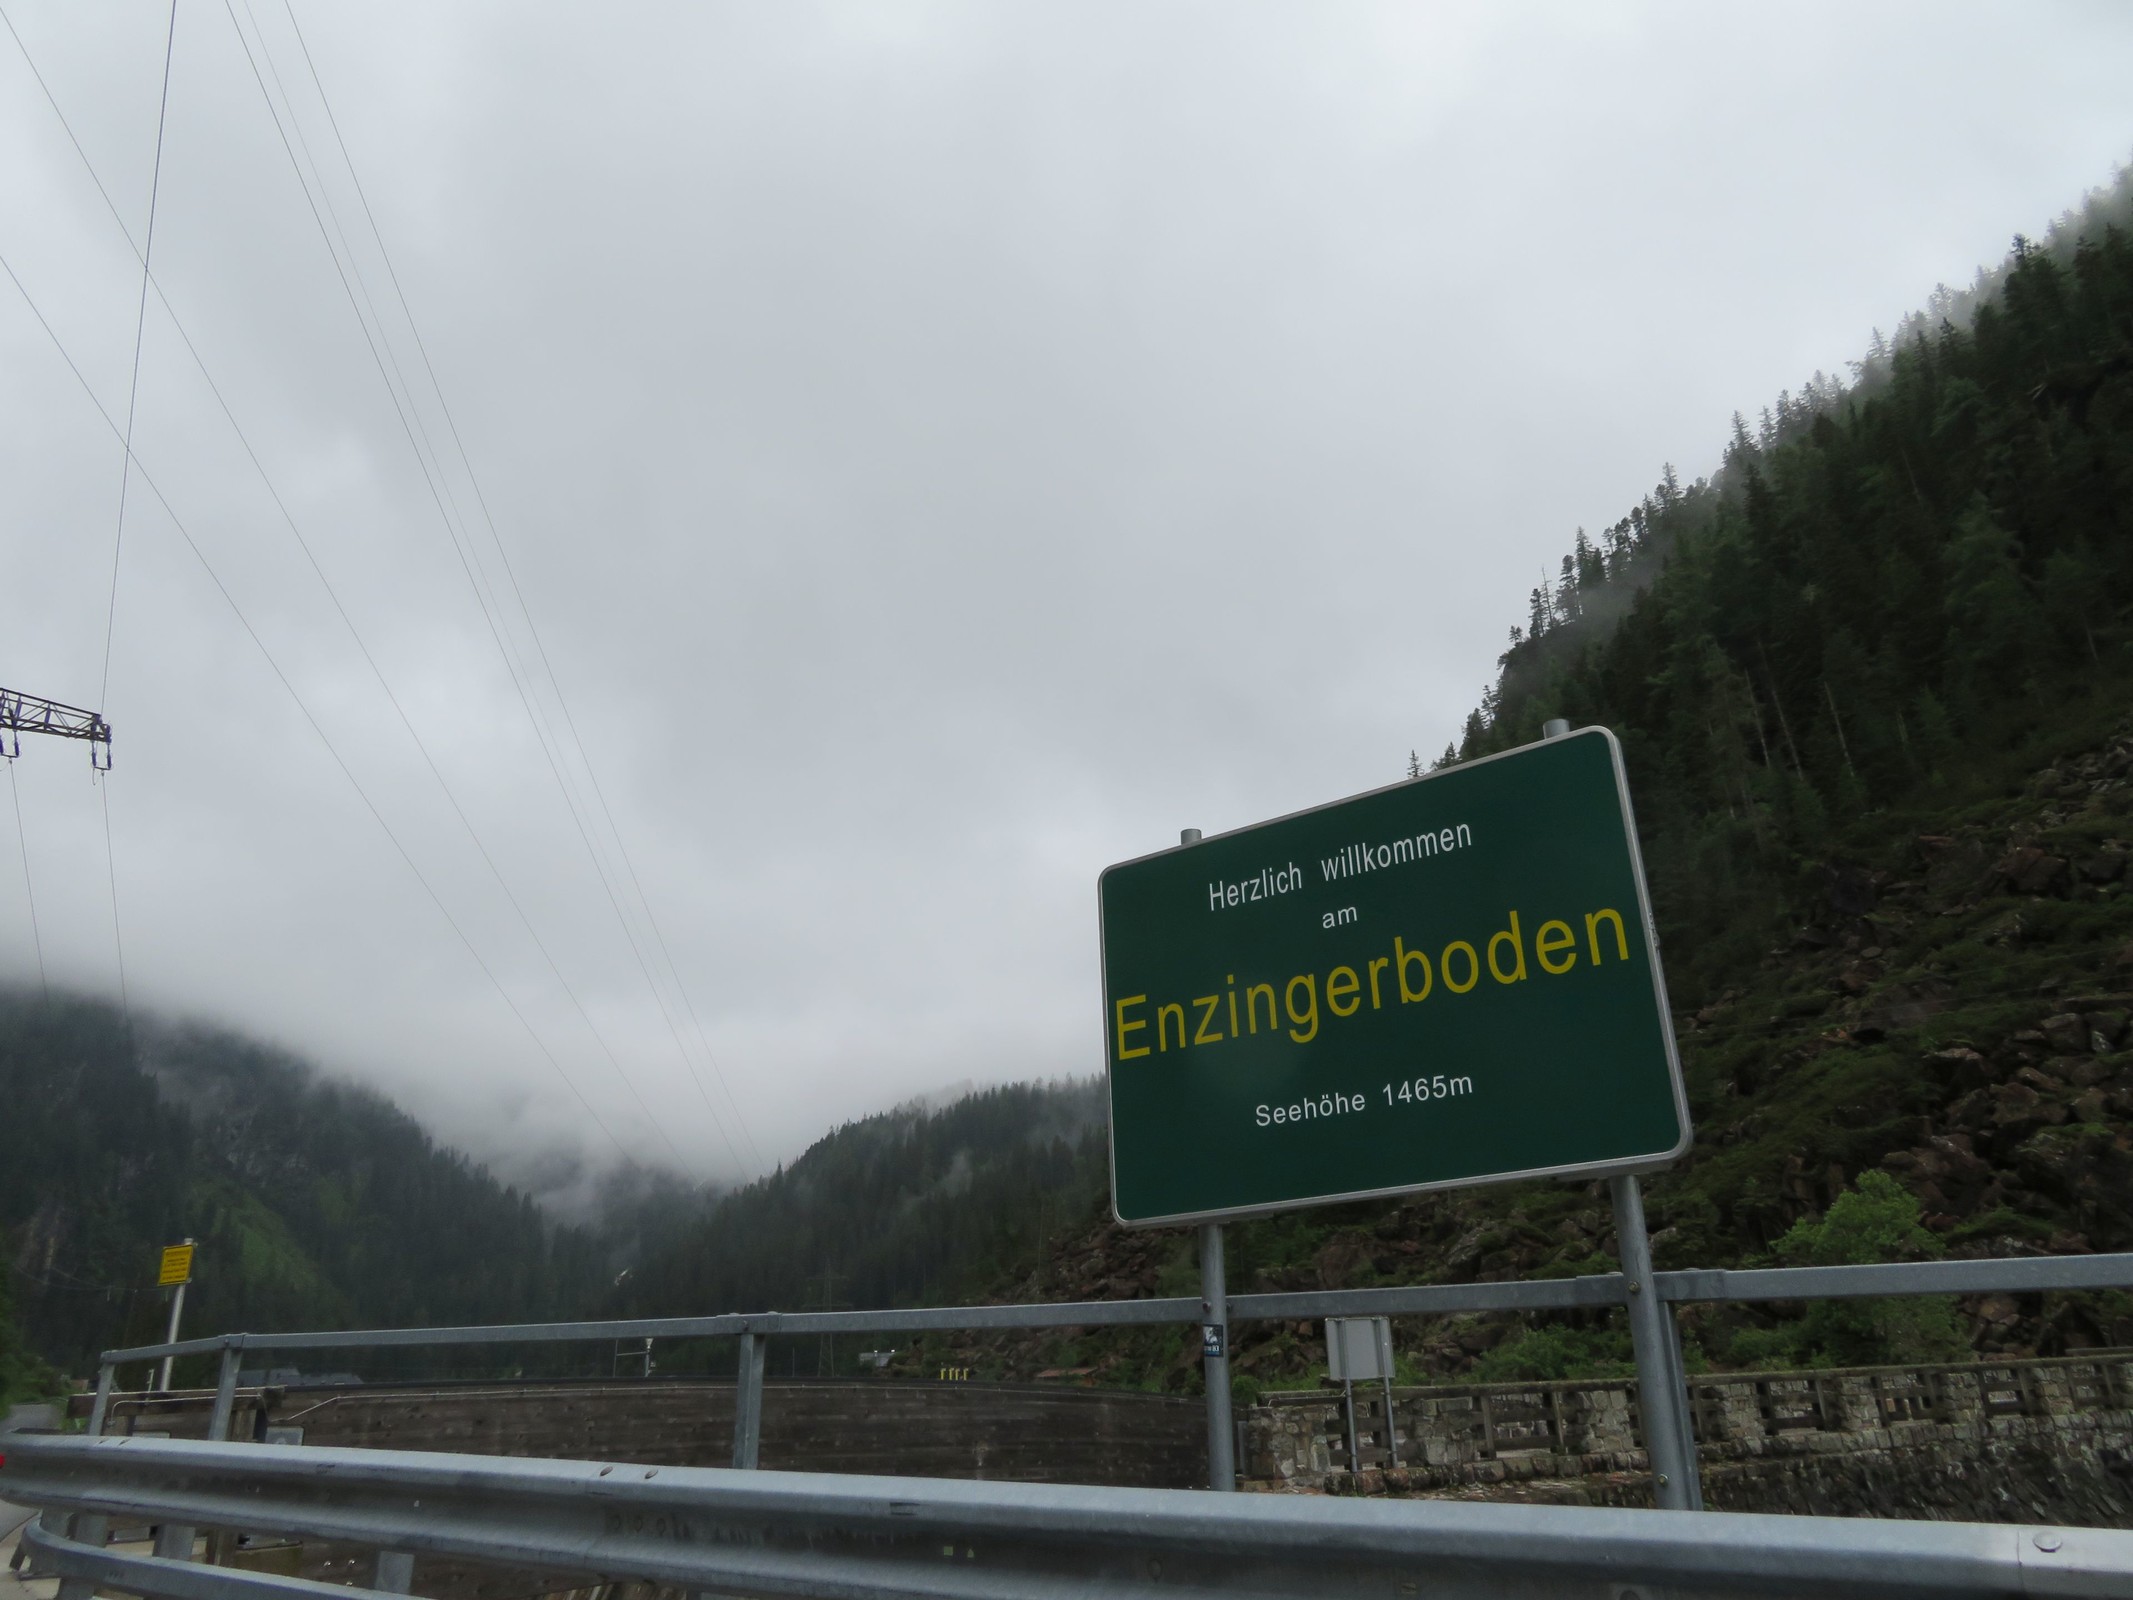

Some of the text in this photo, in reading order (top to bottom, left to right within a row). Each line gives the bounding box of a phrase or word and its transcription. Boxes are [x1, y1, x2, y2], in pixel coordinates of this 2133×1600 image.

[1210, 824, 1471, 911] Herzlich willkommen
[1323, 907, 1357, 928] am
[1117, 908, 1628, 1059] Enzingerboden
[1256, 1075, 1472, 1126] Seehöhe 1465m
